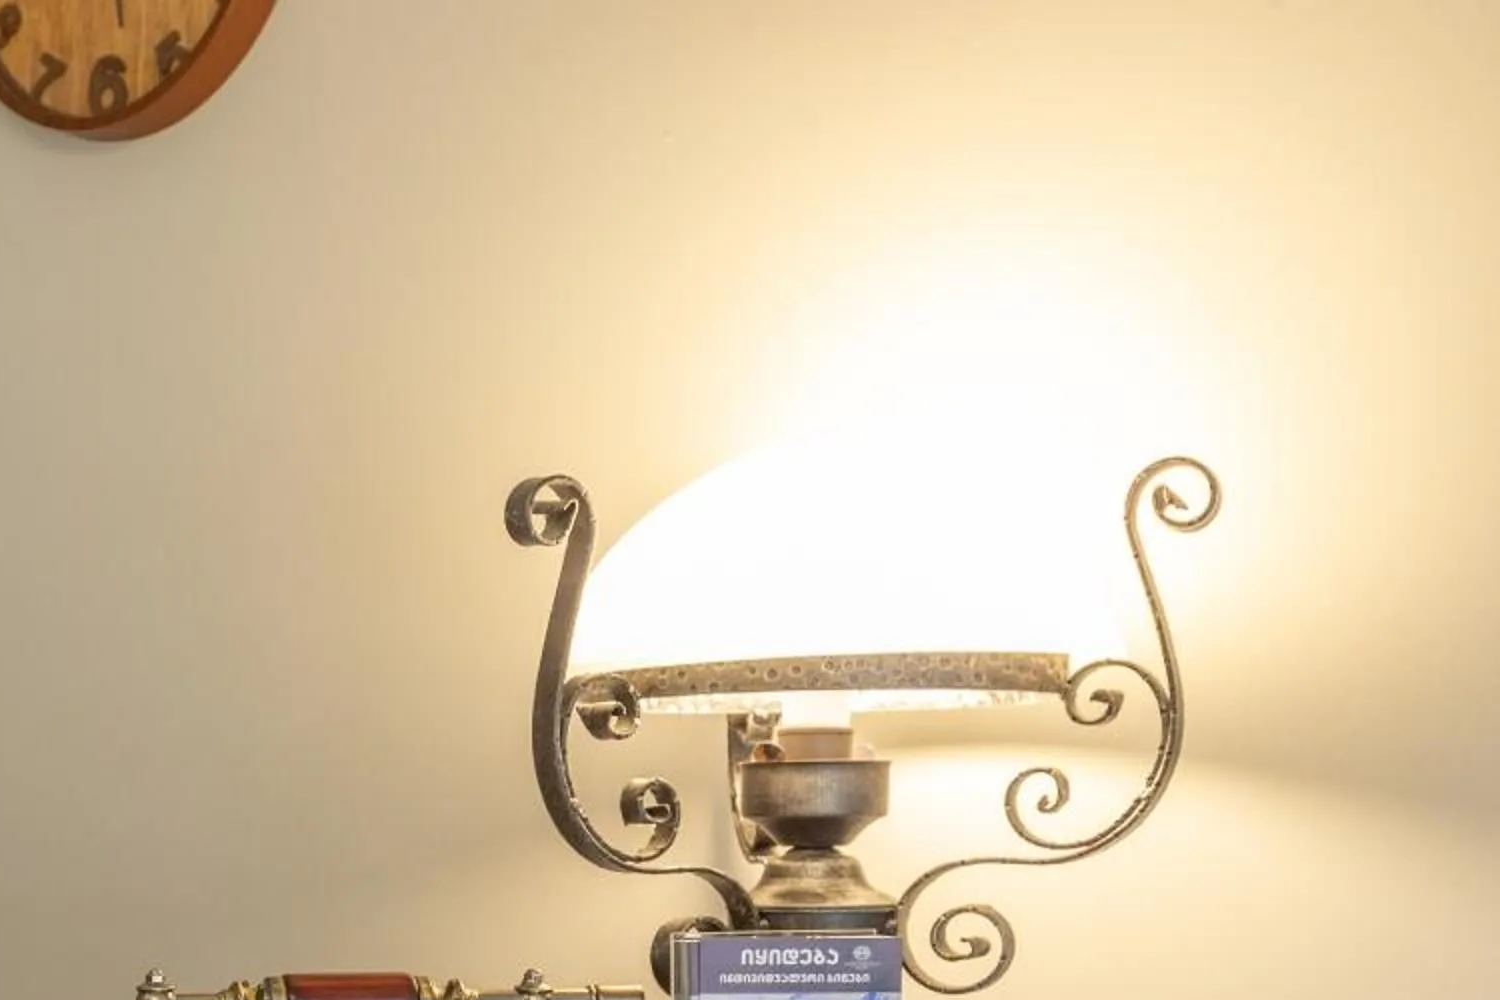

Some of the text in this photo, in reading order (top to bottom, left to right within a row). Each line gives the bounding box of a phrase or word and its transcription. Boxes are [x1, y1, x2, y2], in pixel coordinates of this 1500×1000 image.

[32, 53, 68, 102] 7
[88, 54, 129, 118] 6
[740, 948, 839, 966] იყიდება
